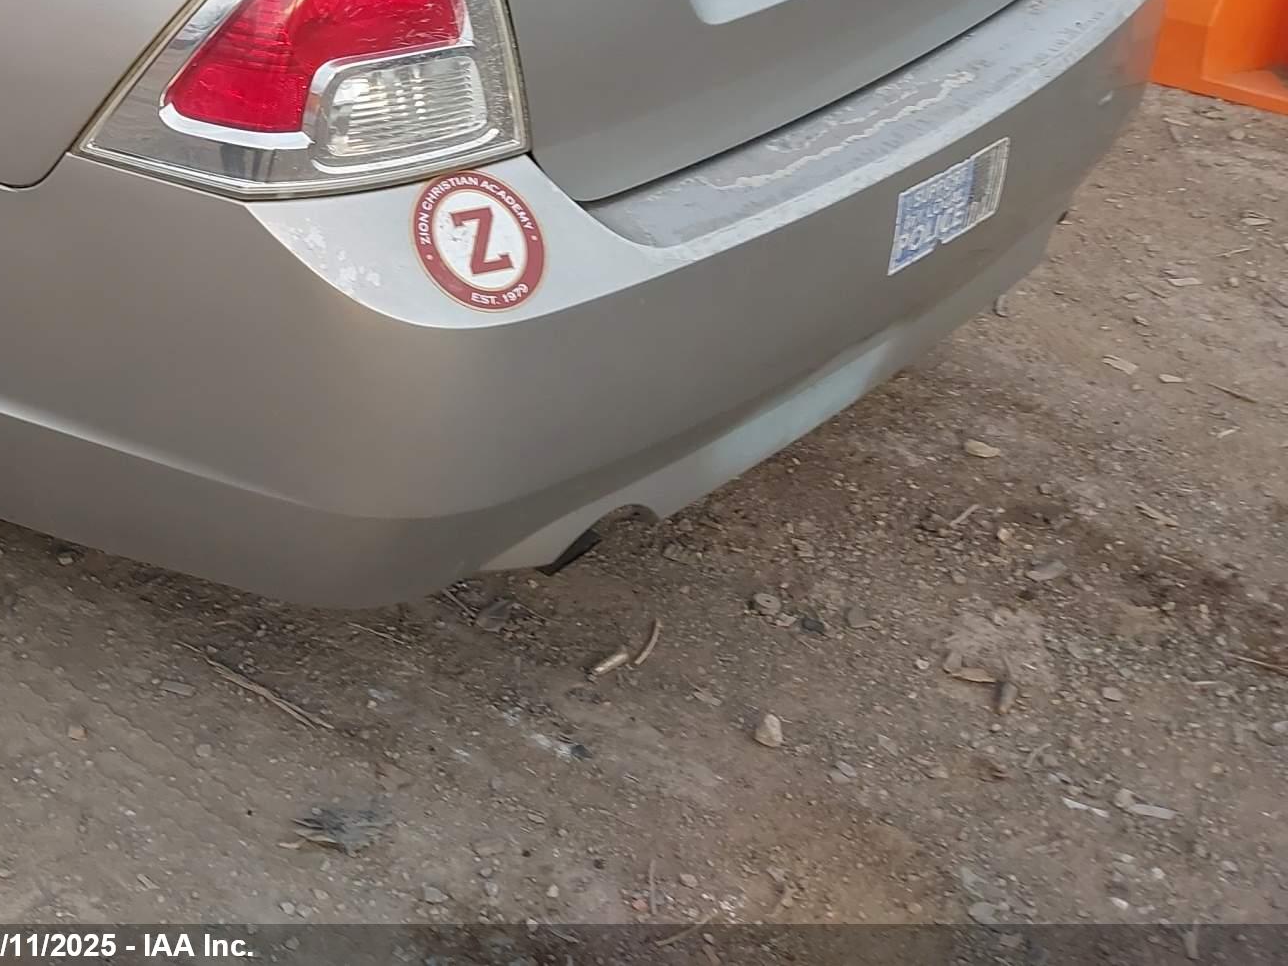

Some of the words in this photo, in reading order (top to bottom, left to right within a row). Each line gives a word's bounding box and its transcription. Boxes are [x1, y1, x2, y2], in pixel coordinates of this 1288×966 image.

[421, 176, 479, 211] CHRISTIAN
[480, 180, 535, 231] ACADEMY
[418, 212, 431, 246] ZION
[451, 207, 513, 275] Z
[471, 292, 501, 306] EST.
